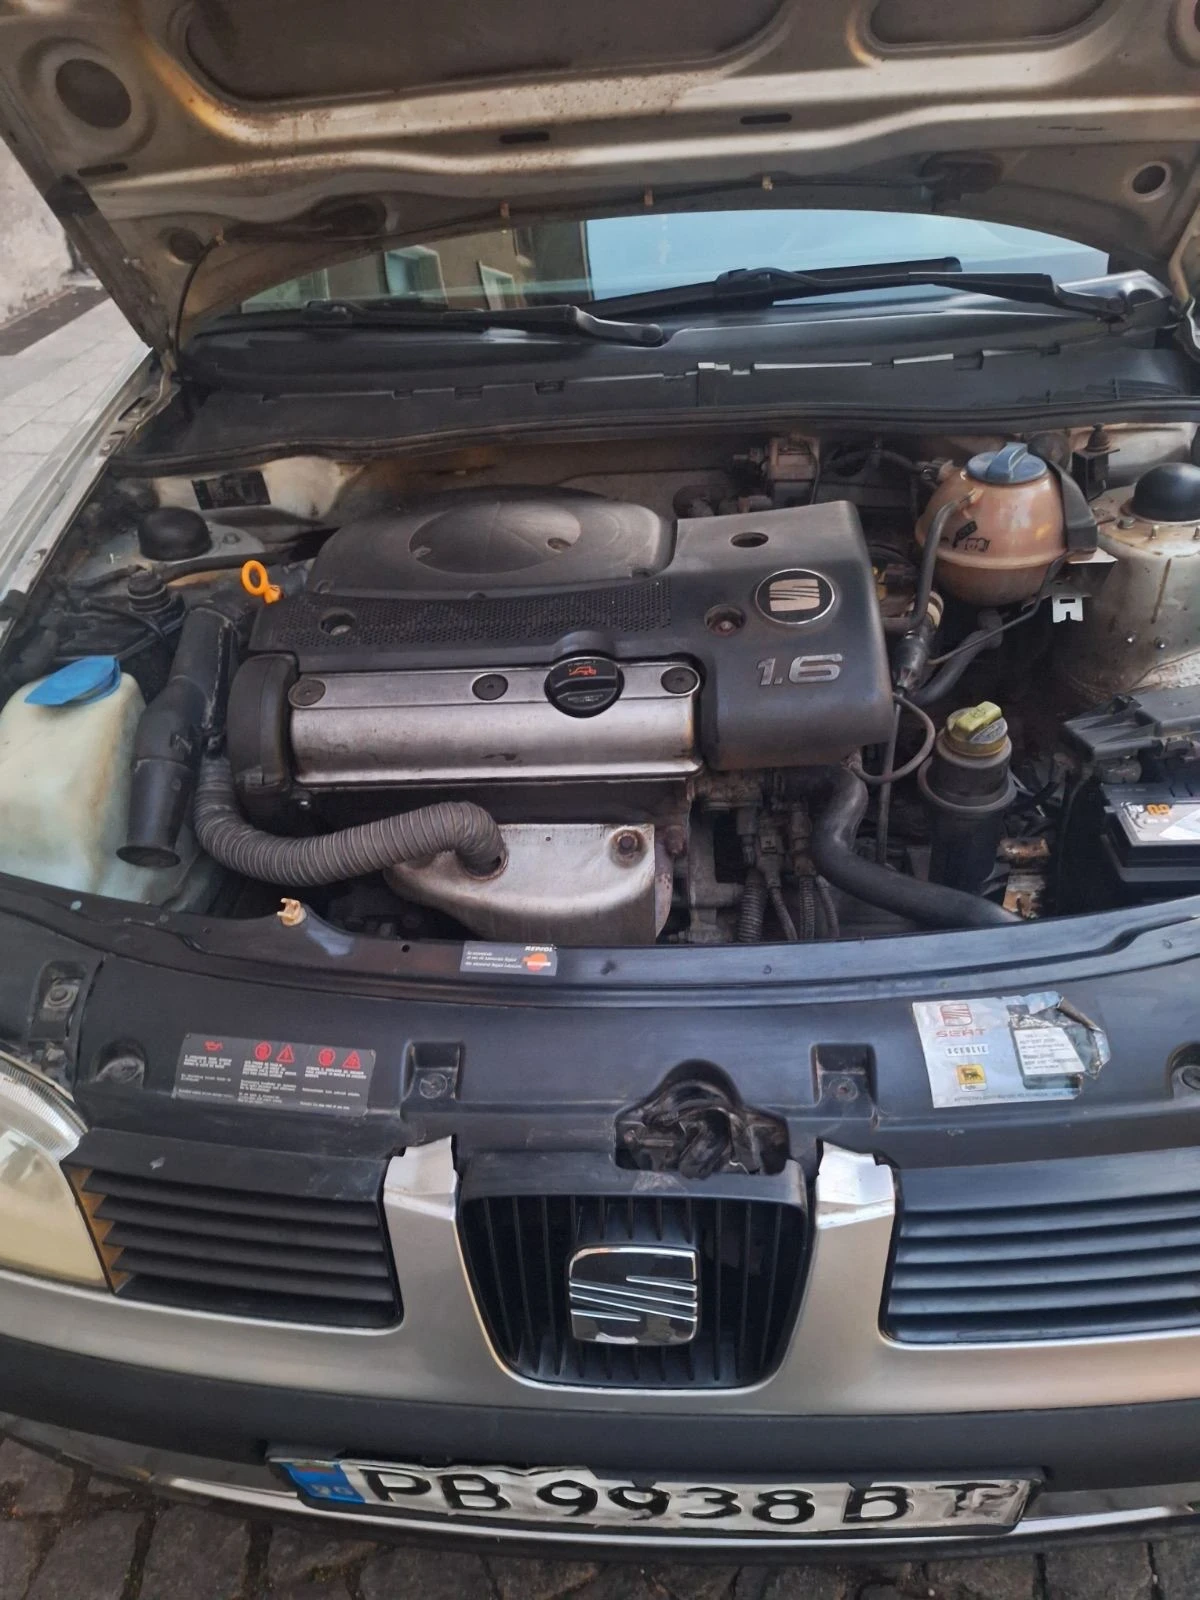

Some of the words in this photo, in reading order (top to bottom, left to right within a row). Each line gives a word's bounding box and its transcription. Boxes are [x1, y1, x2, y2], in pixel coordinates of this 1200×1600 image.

[757, 653, 843, 686] 1.6
[935, 1027, 987, 1038] SEAT
[360, 1467, 511, 1511] PB
[535, 1479, 816, 1525] 9938
